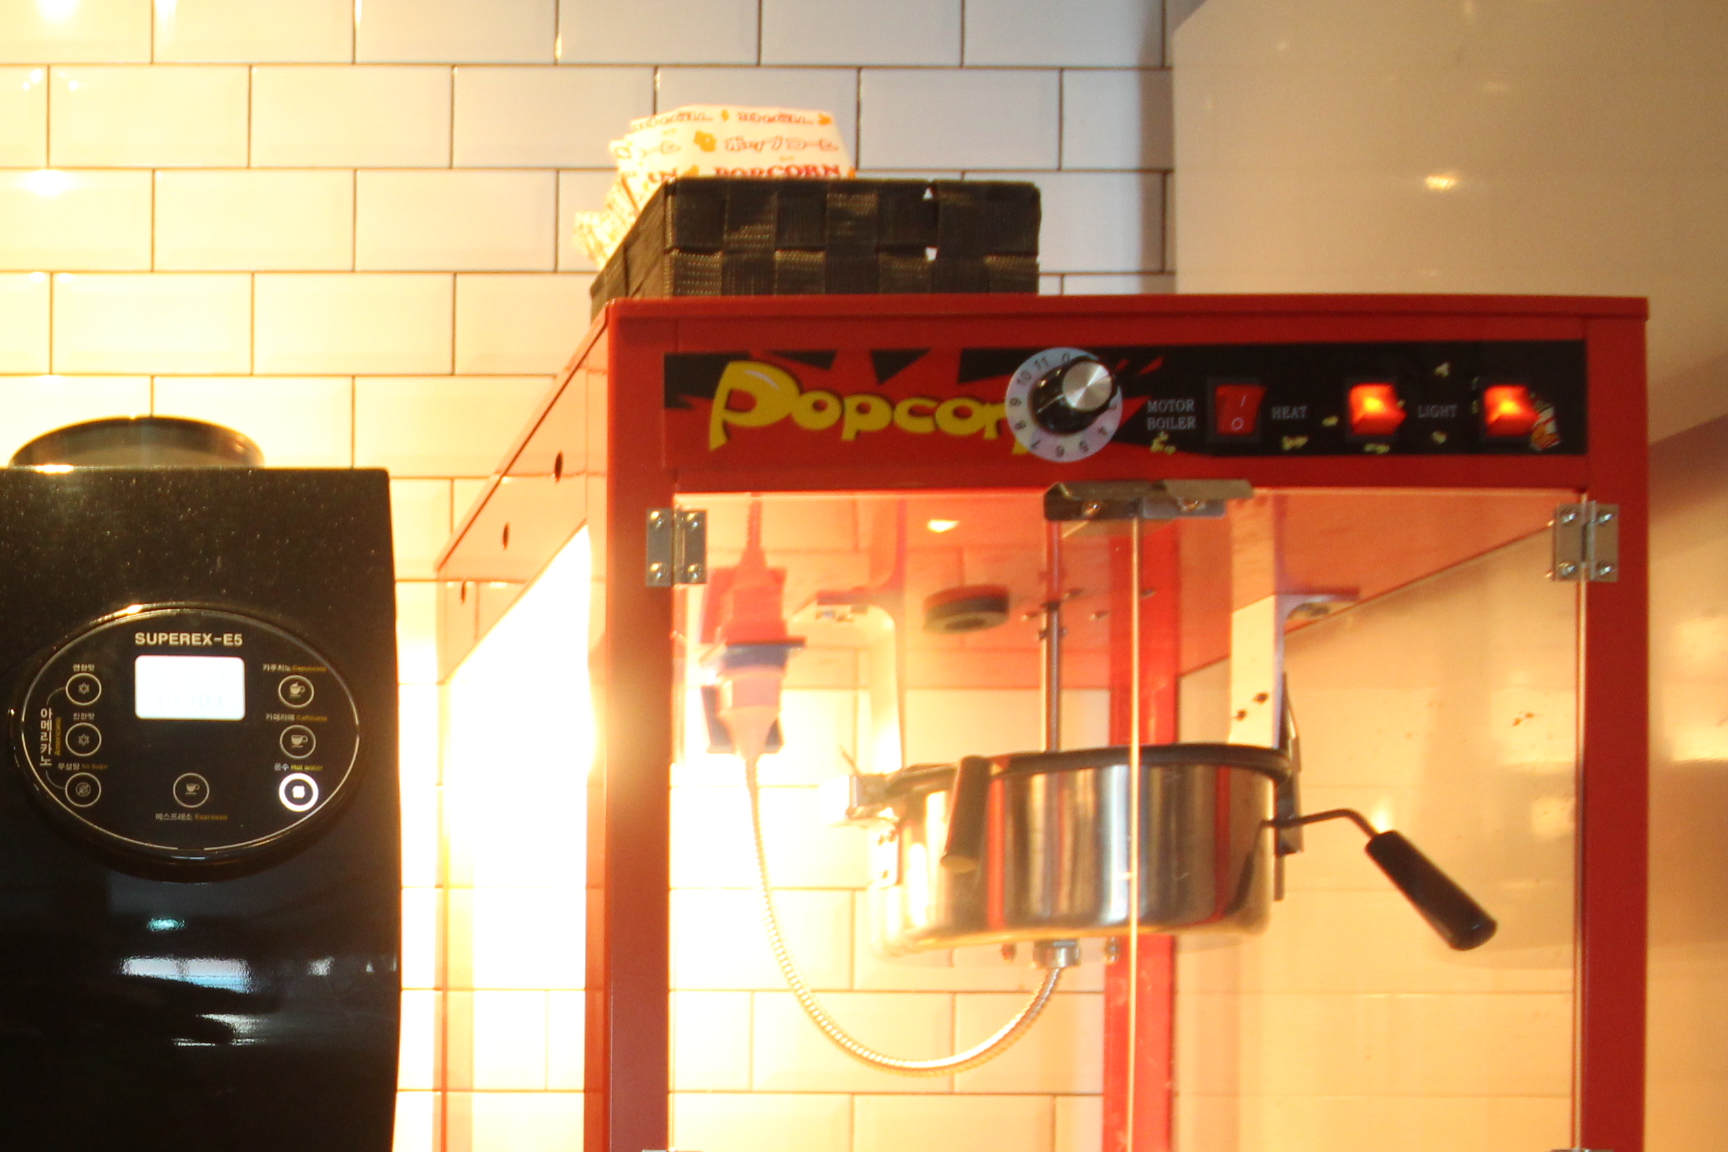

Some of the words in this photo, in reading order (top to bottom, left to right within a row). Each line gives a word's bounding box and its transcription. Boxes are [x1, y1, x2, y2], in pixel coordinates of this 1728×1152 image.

[709, 360, 1034, 455] Popcor
[1146, 399, 1196, 414] MOTOR
[1272, 405, 1307, 420] HEAT
[1417, 404, 1459, 420] LIGHT
[1146, 415, 1197, 431] BOILER
[134, 632, 243, 646] SUPEREX-E5
[39, 707, 52, 767] 아메리카노
[155, 812, 192, 821] 에스프레소
